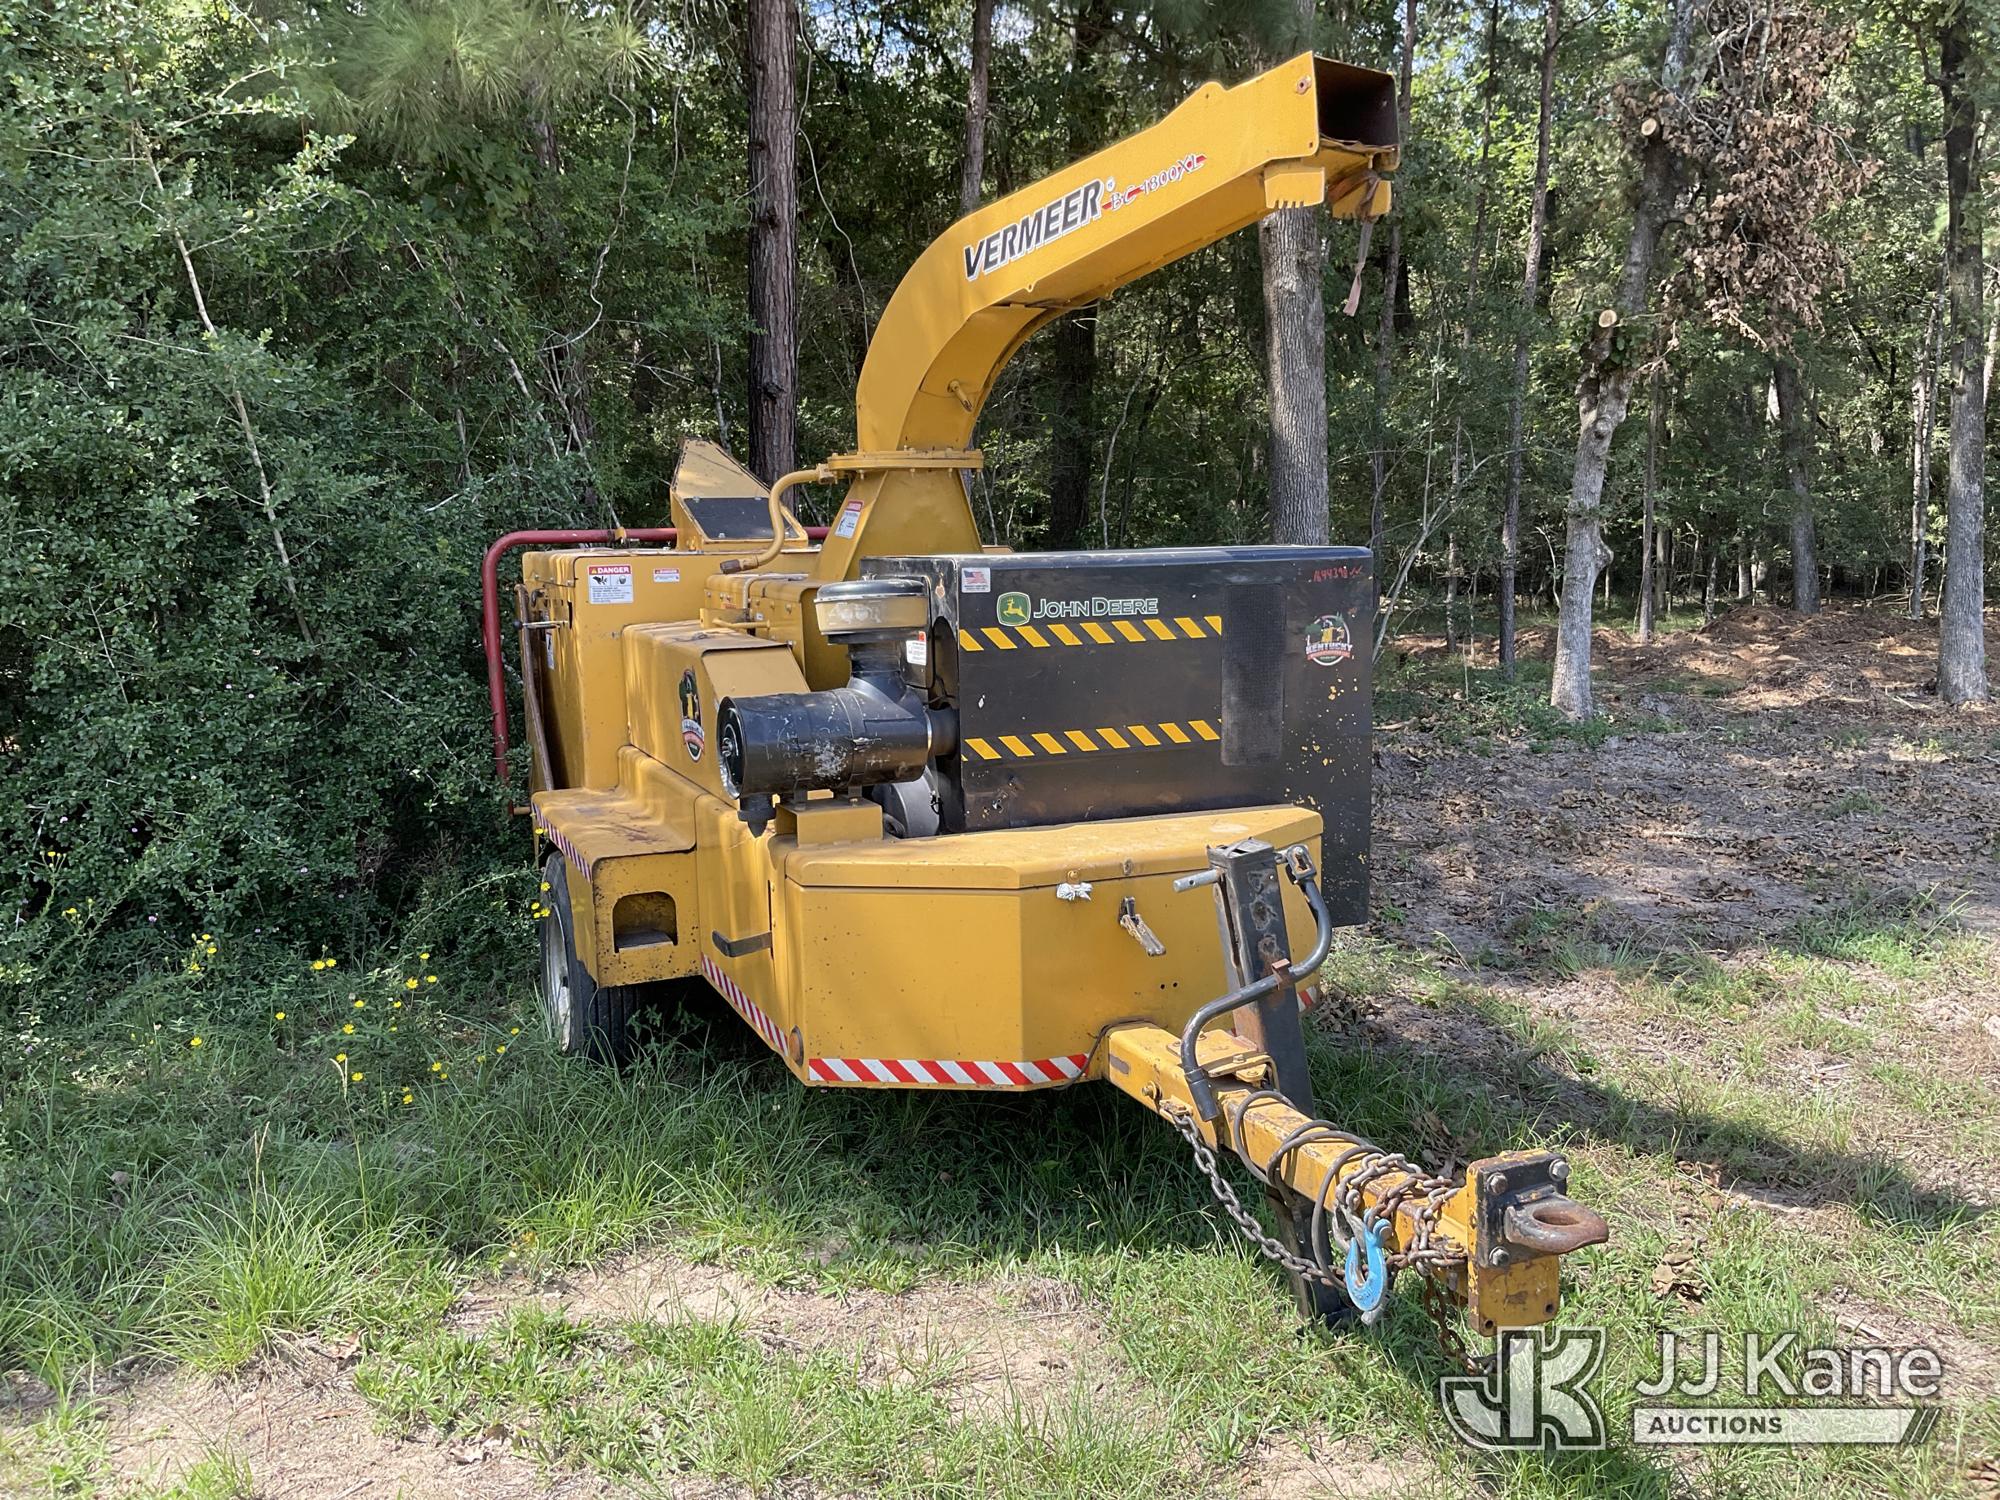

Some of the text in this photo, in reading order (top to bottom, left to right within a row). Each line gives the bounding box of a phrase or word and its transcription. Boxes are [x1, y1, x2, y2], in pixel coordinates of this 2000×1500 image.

[964, 178, 1103, 281] VERMEER
[597, 566, 629, 574] DANGER
[1034, 597, 1158, 618] JOHN DEERE
[1306, 642, 1352, 655] KENTUCKY
